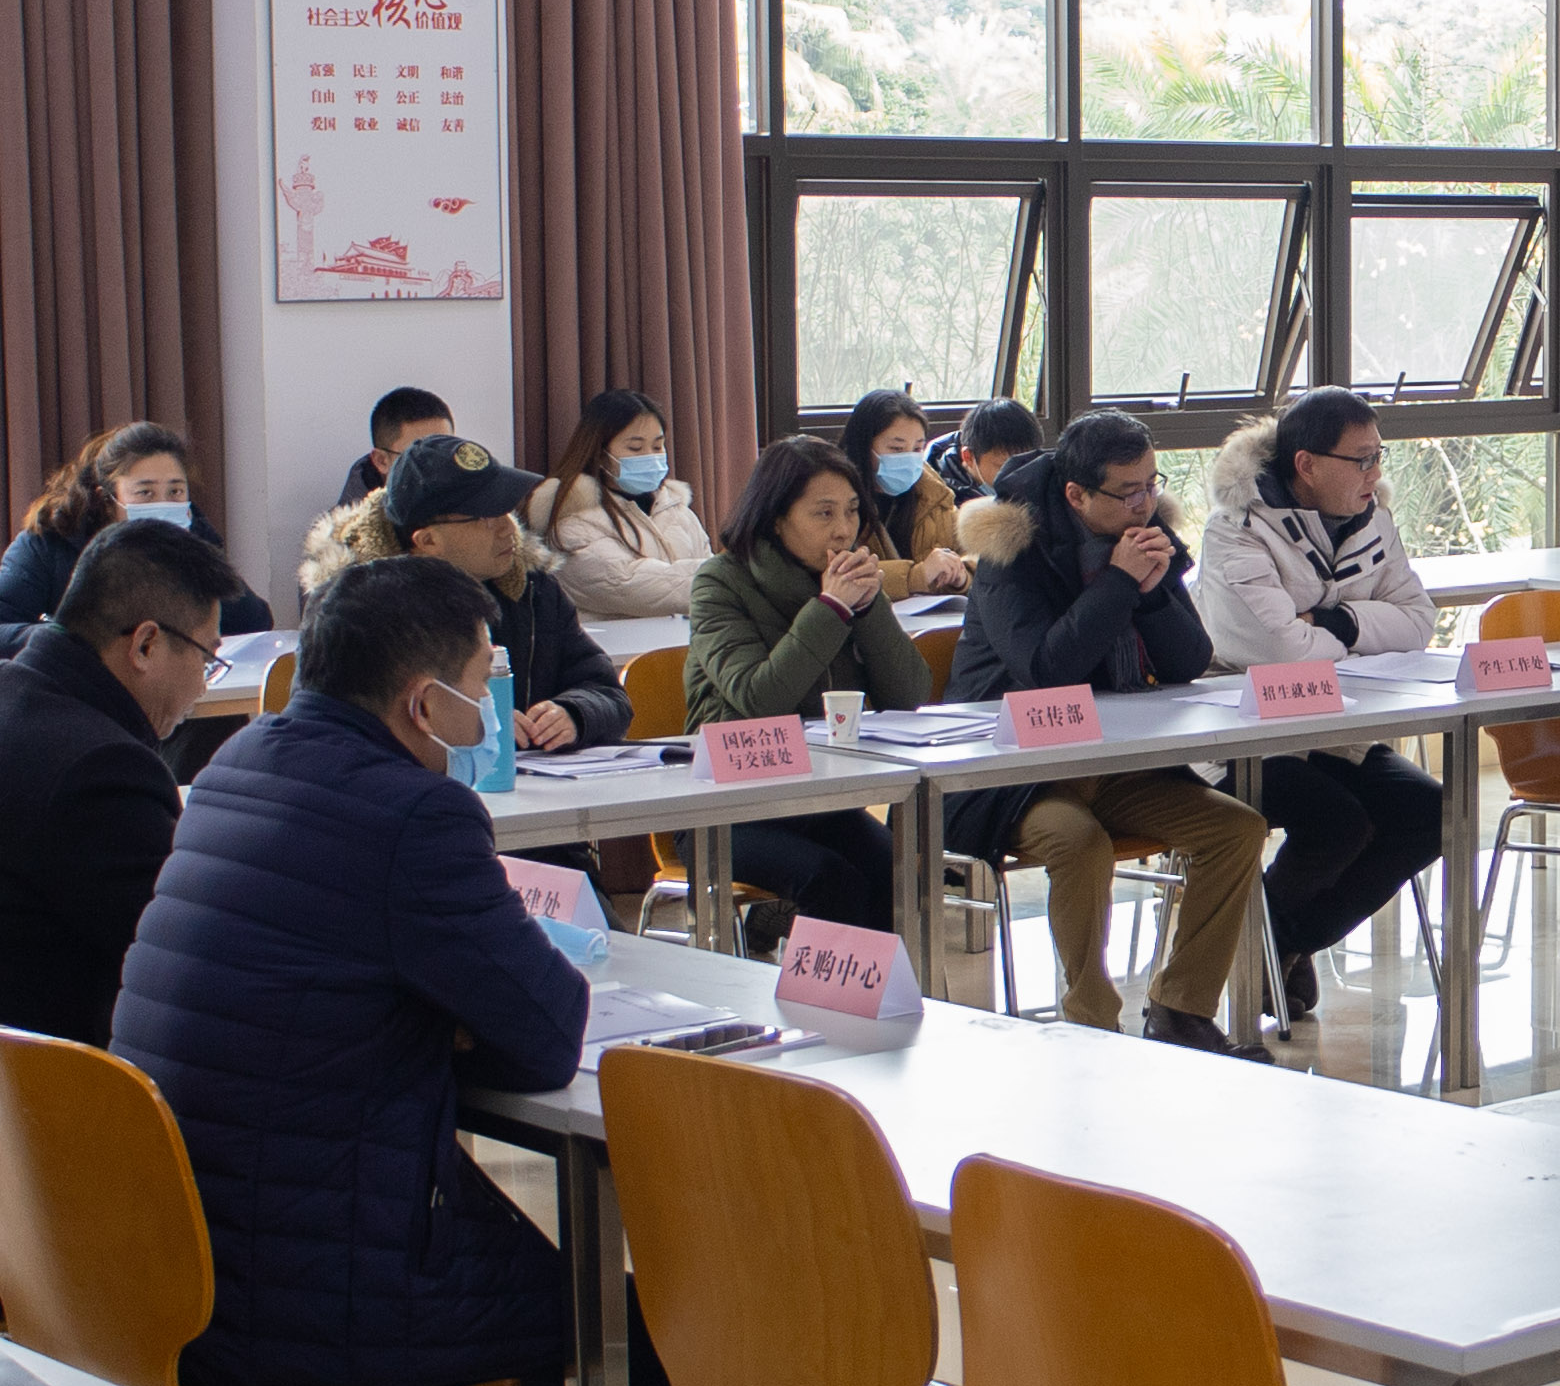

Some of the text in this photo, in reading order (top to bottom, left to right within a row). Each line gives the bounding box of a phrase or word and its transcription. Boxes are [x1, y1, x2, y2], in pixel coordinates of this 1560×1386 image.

[307, 7, 369, 28] 社会主义
[415, 11, 463, 30] 价值观
[310, 64, 464, 80] 富强 民主 文明 和谐
[312, 90, 464, 106] 自由 平等 公正 法治
[311, 116, 464, 133] 爱国 敬业 诚信 友善
[1479, 655, 1544, 675] 学生工作处
[1262, 680, 1334, 702] 招生就业处
[1026, 703, 1085, 728] 宣传部
[722, 726, 790, 750] 国际合作
[728, 747, 793, 771] 与交流处
[514, 883, 561, 920] 建处
[787, 945, 882, 990] 采购中心
